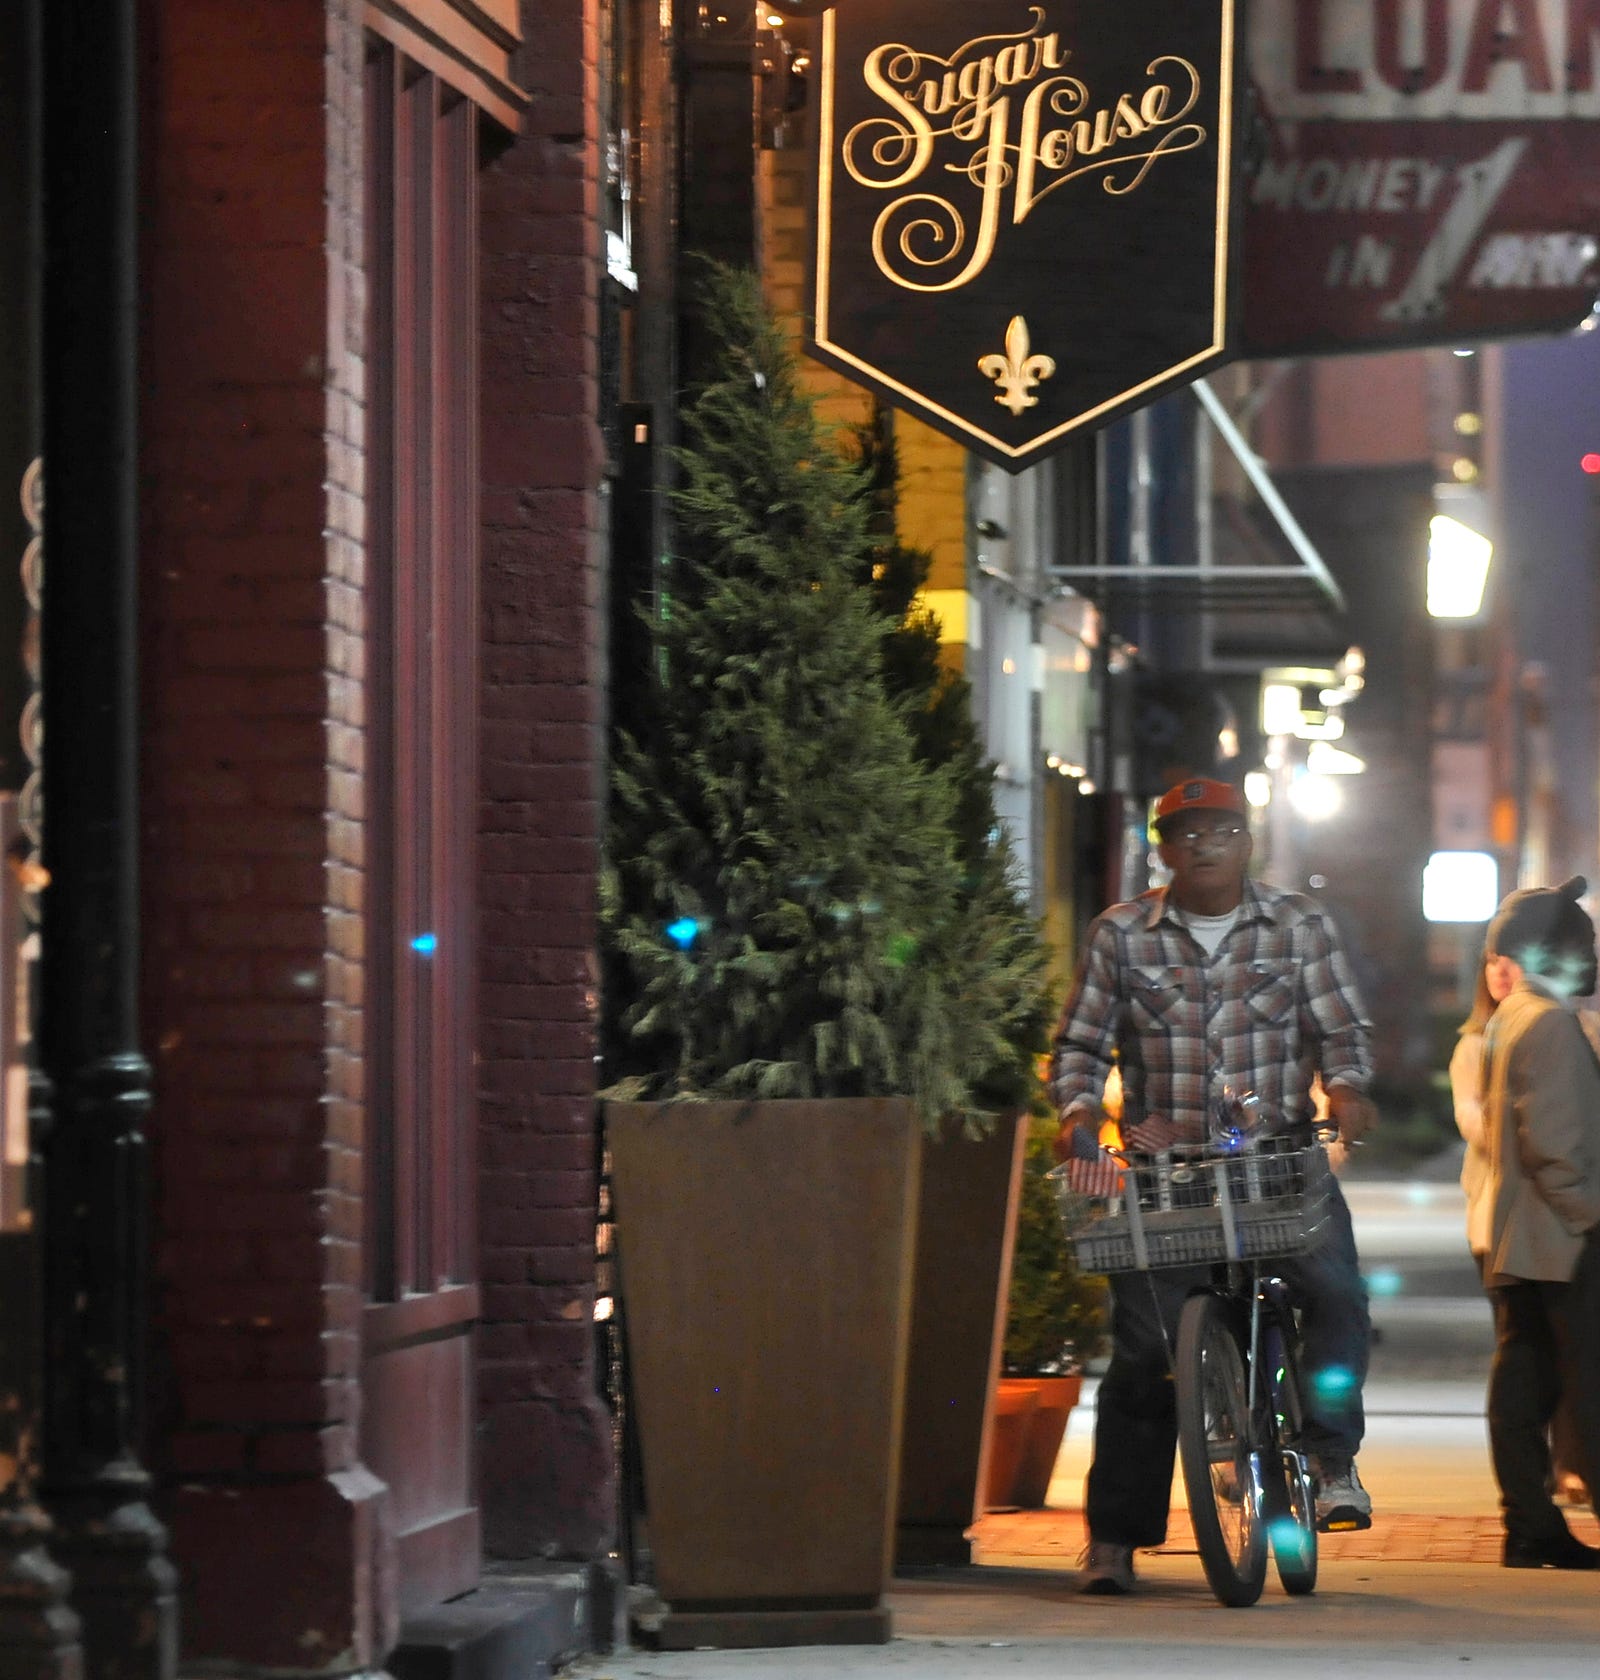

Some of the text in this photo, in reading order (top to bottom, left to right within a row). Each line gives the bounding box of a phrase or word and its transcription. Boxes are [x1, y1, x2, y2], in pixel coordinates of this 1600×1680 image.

[842, 6, 1072, 188] Sugar
[872, 55, 1206, 292] House
[1252, 157, 1444, 212] MONEY
